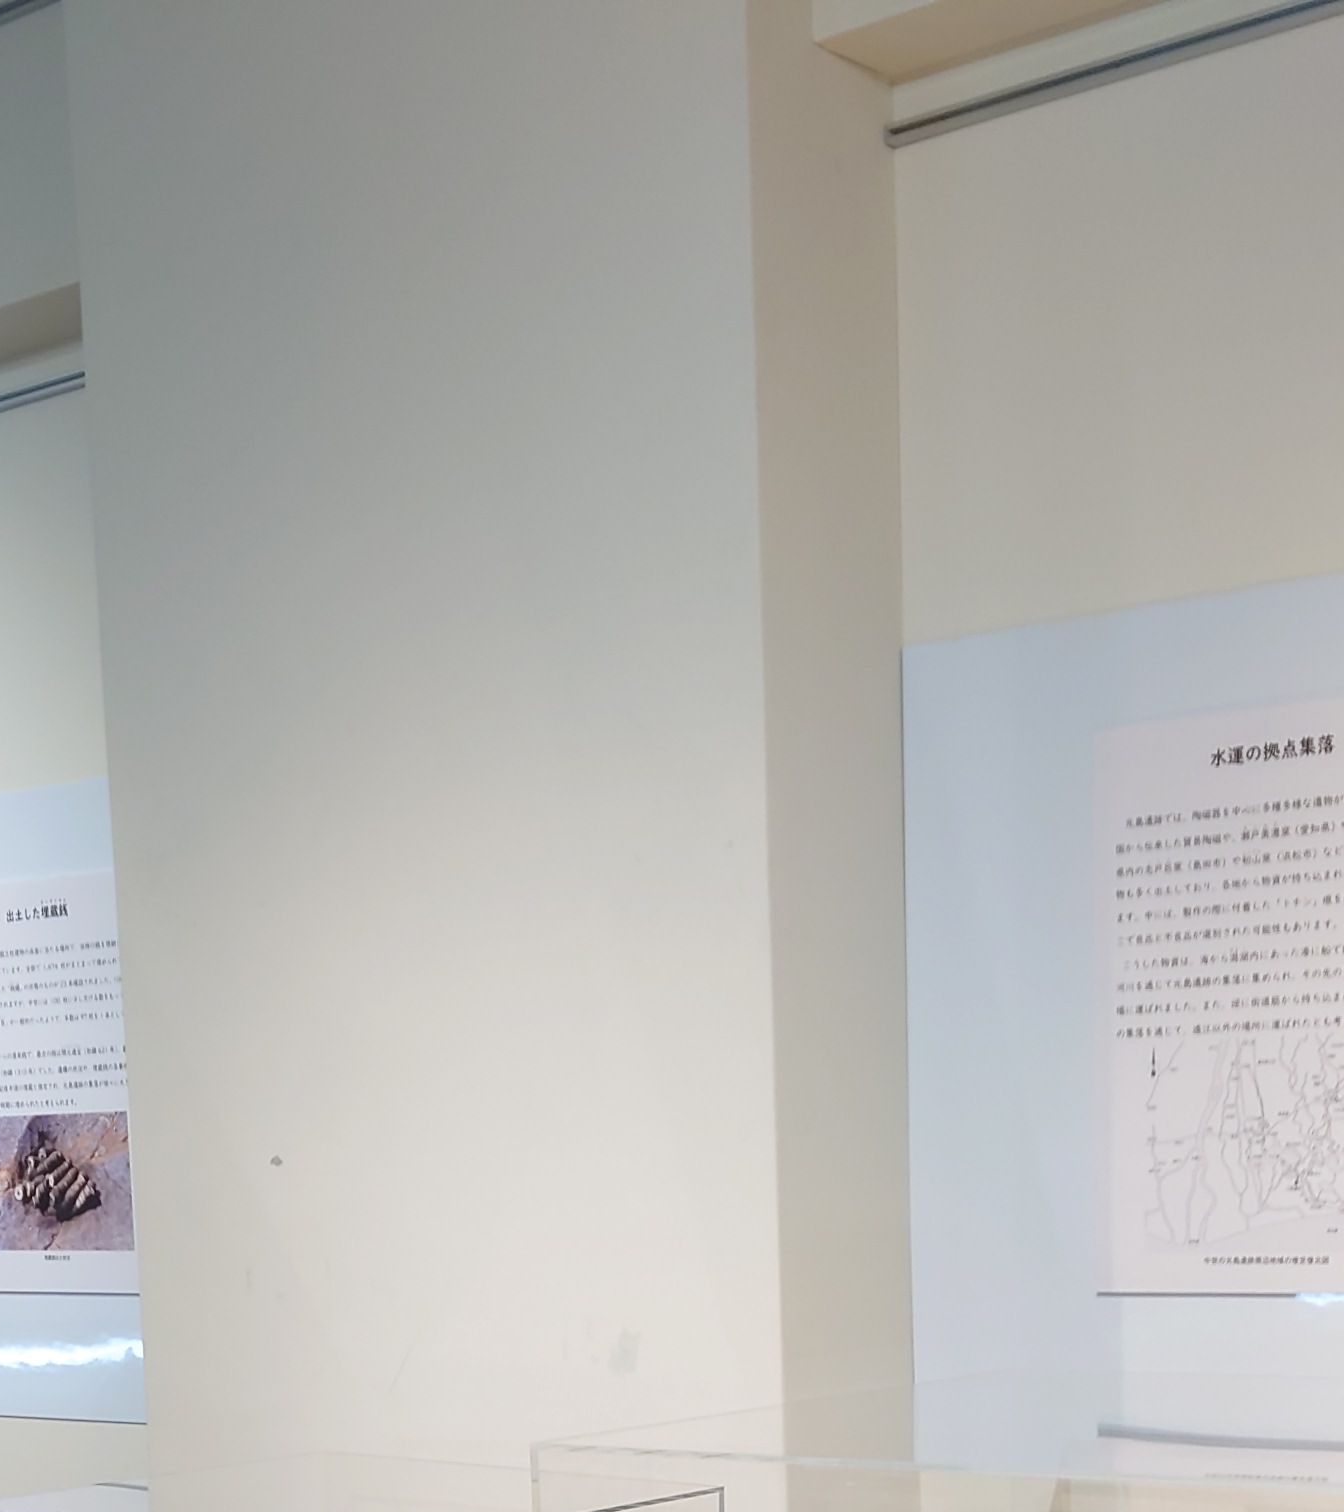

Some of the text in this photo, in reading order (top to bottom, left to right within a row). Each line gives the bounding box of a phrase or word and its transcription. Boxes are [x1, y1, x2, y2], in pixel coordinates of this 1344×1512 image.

[1210, 732, 1336, 768] 水運の拠点集落
